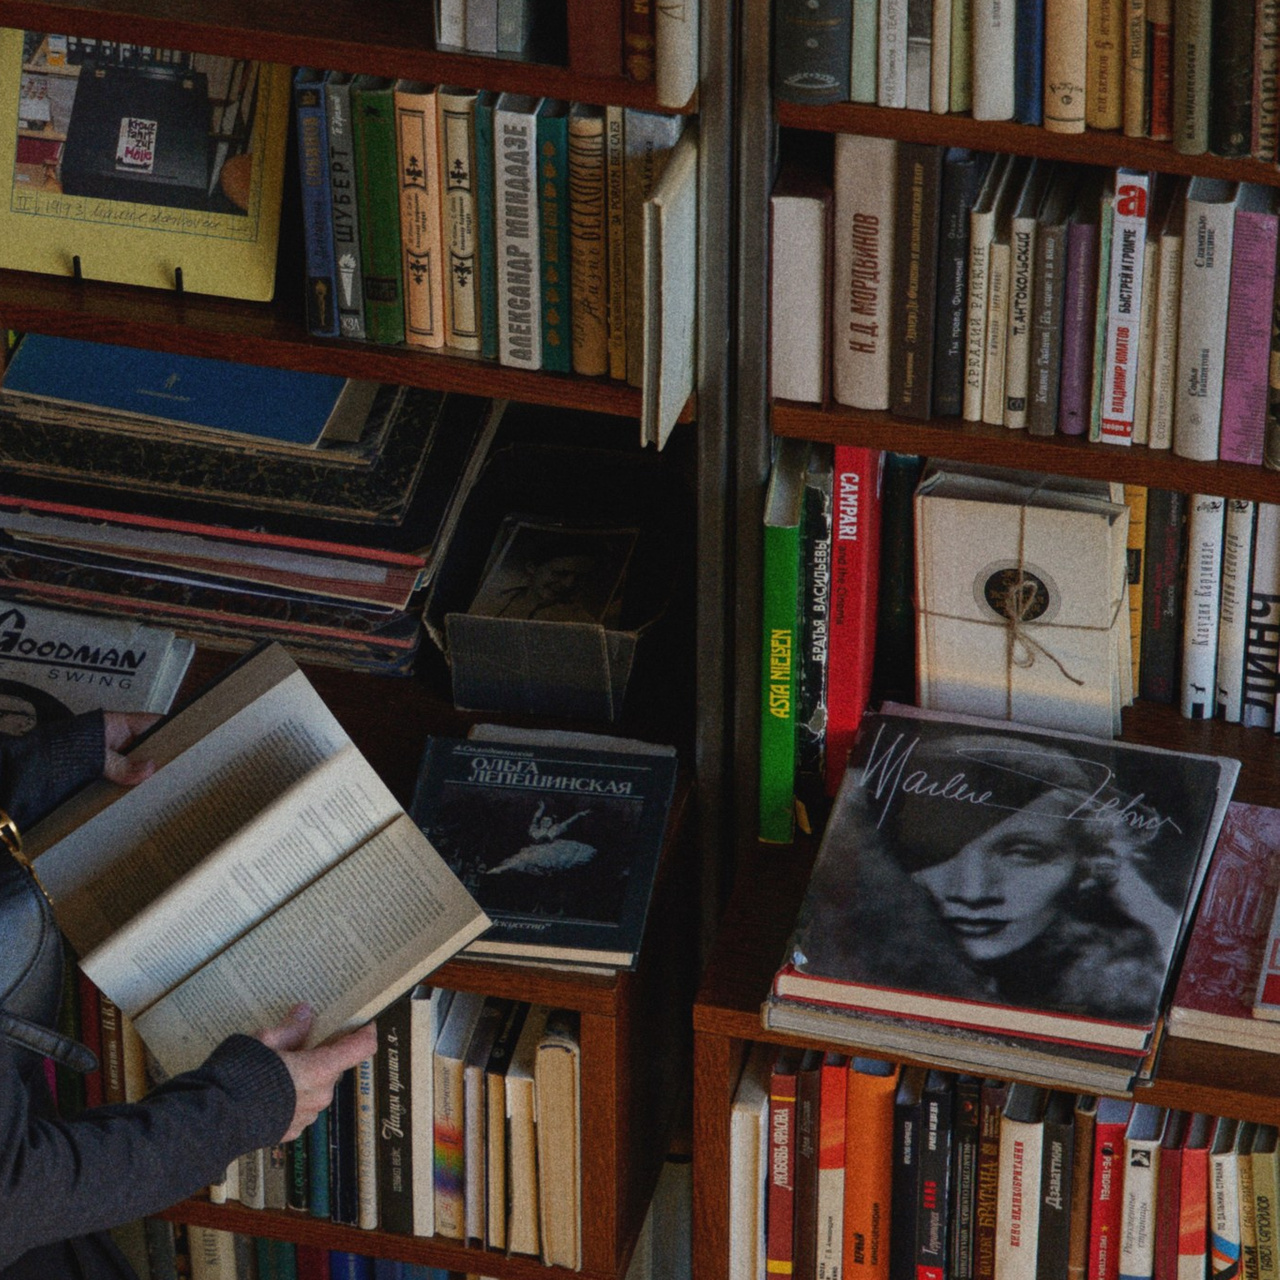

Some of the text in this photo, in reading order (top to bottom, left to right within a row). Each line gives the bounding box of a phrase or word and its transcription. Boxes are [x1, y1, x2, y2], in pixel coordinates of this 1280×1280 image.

[326, 143, 358, 244] ШУБЕРТ
[606, 147, 620, 168] БЕЗ
[498, 120, 534, 362] АЛЕКСАНДР МИНДАДЗЕ
[847, 212, 883, 354] Н. Д. МОРДВИНОВ
[1011, 230, 1030, 337] П. АНТОКОЛЬСКИЙ
[1115, 228, 1136, 314] БЫСТРЕЙ И ГРОМЧЕ
[947, 255, 964, 355] Ты права, Филумена!
[965, 244, 985, 390] АРКАДИЙ РАЙКИН
[1109, 326, 1130, 413] ВЛАДИМИР ЮМАТОВ
[1186, 366, 1199, 396] Софья
[834, 470, 862, 542] CAMPARI
[810, 538, 829, 661] БРАТЬЯ ВАСИЛЬЕВЫ
[835, 566, 847, 583] the
[1191, 601, 1214, 647] Клаудия
[45, 664, 136, 694] SWING
[770, 627, 791, 718] ASTA NIELSEN
[467, 768, 634, 796] ЛЕПЕШИНСКАЯ
[470, 755, 542, 775] ОЛЬГА
[770, 1105, 797, 1190] ЛЮБОВЬ ОРЛОВА
[975, 1160, 998, 1227] БРАТАНА
[1008, 1138, 1026, 1248] КИНО ВЕЛИКОБРИТАНИИ
[1255, 1194, 1273, 1239] САМОЙЛОВ
